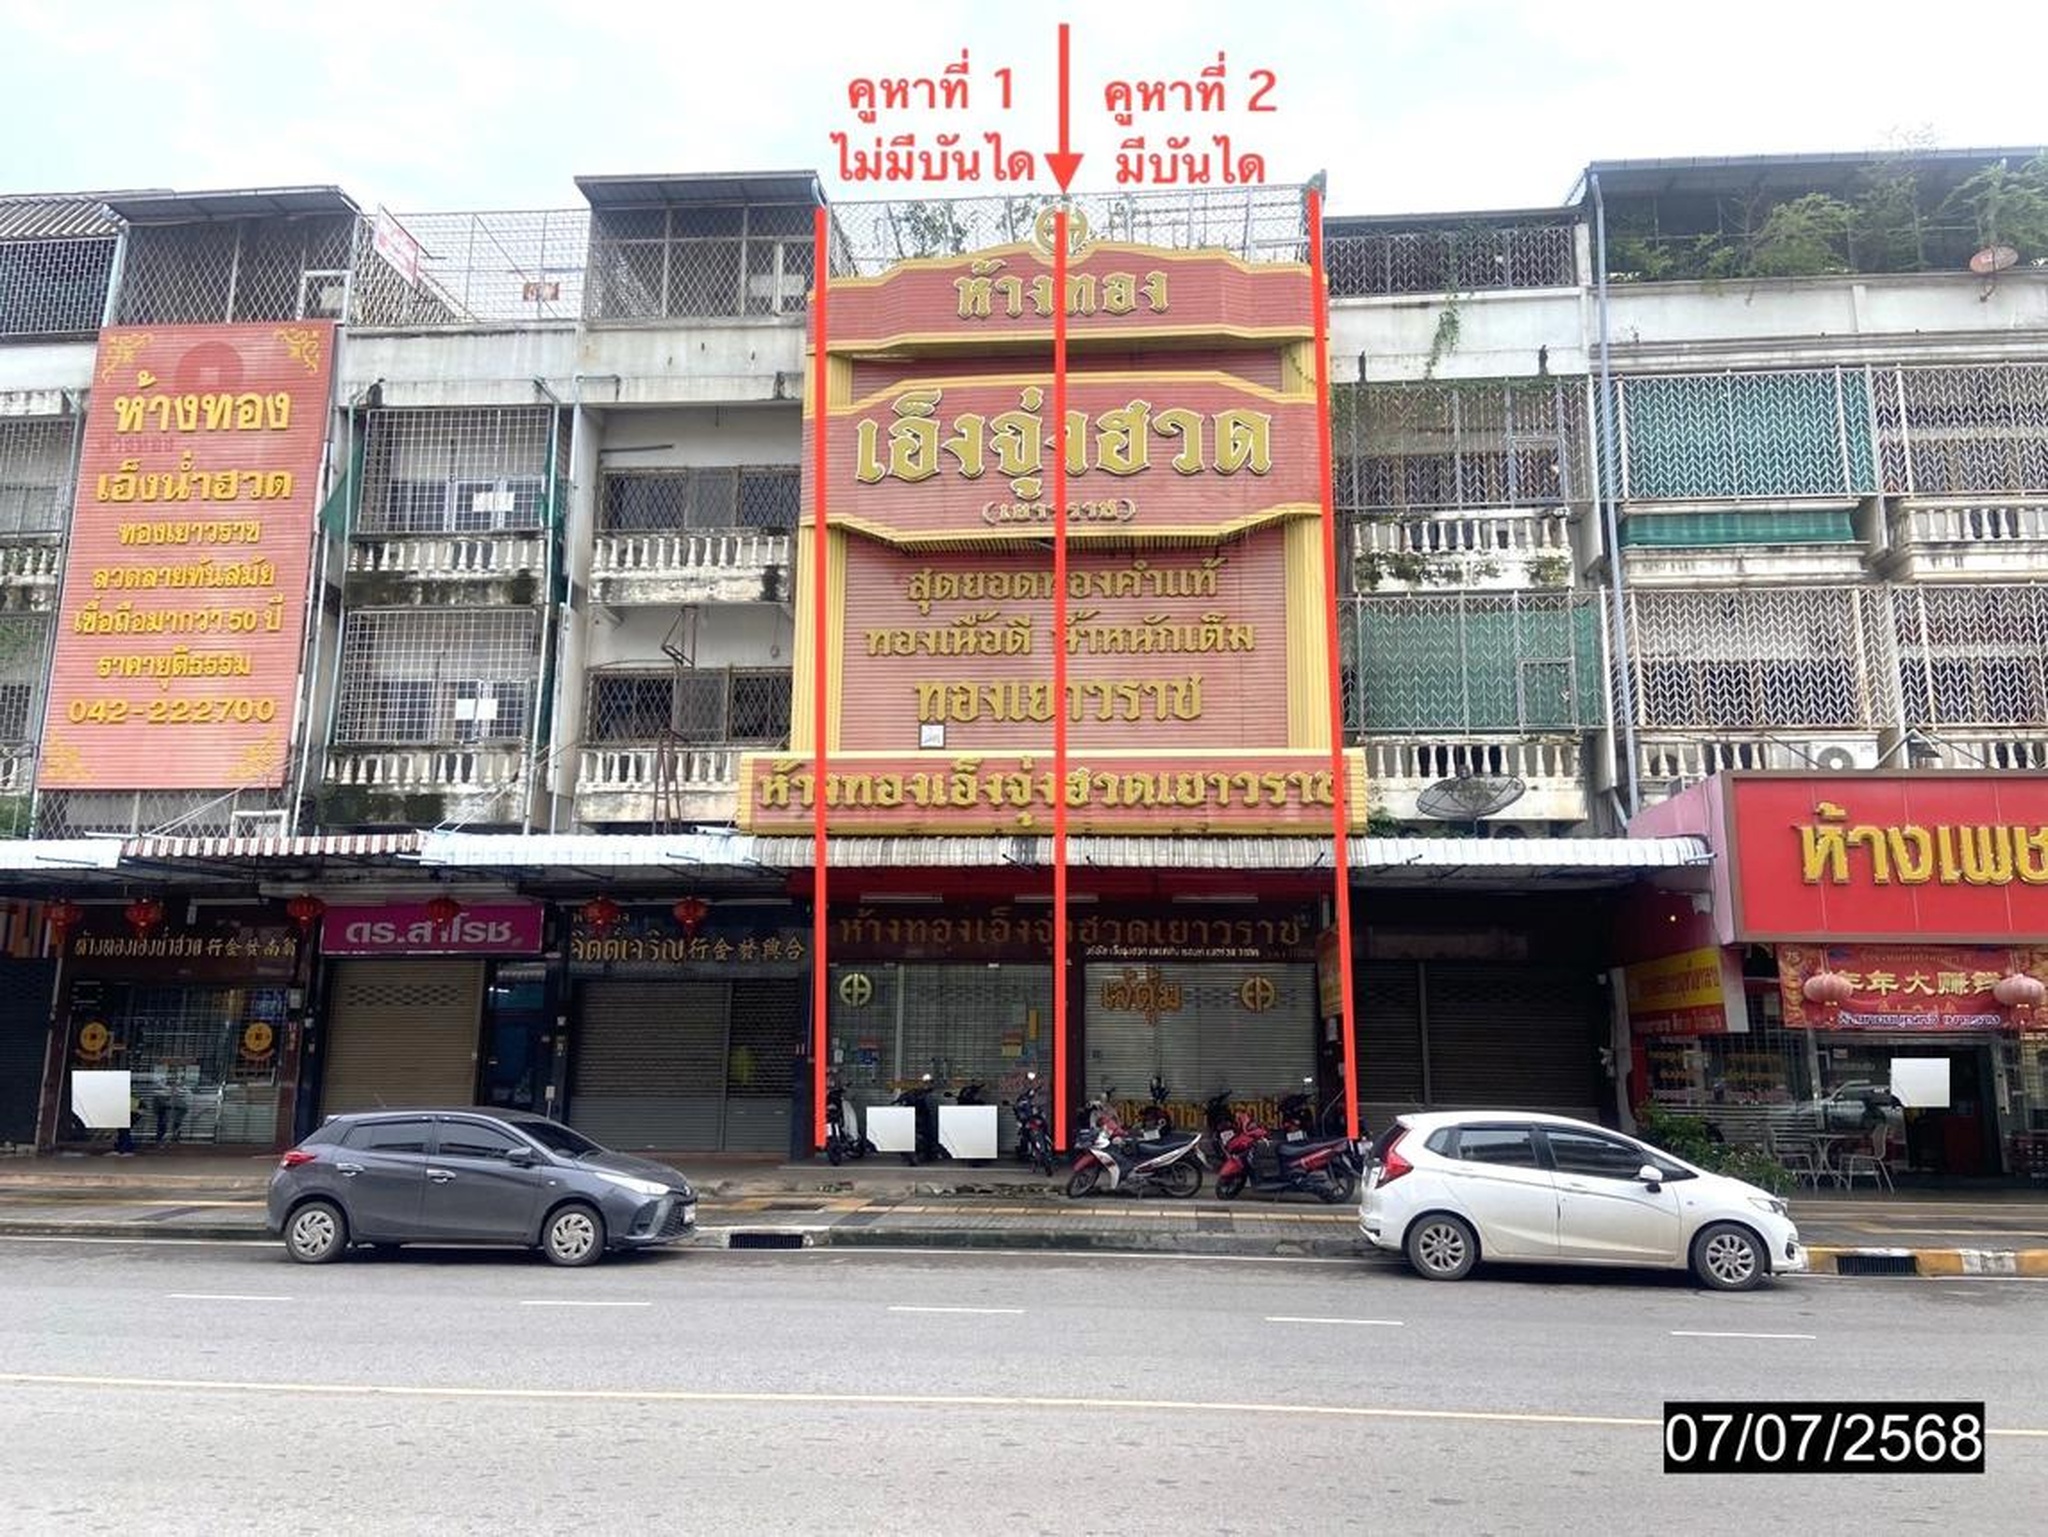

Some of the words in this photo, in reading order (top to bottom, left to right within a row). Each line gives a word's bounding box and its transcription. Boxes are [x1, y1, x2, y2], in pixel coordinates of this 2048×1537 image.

[953, 258, 1169, 320] ห้างทอง
[113, 369, 291, 433] ห้างทอง
[855, 386, 1272, 501] เอ็งจุ่งฮวด
[118, 519, 262, 546] ทองเยาวราช
[92, 556, 276, 589] ลวดลายทันสมัย
[228, 610, 257, 631] 50
[264, 593, 284, 631] ปี
[864, 609, 1032, 657] ทองเนื้อดี
[97, 644, 253, 692] ราคายุติธรรม
[68, 698, 276, 724] 042-222700
[913, 673, 1204, 724] ทองเยาวราช
